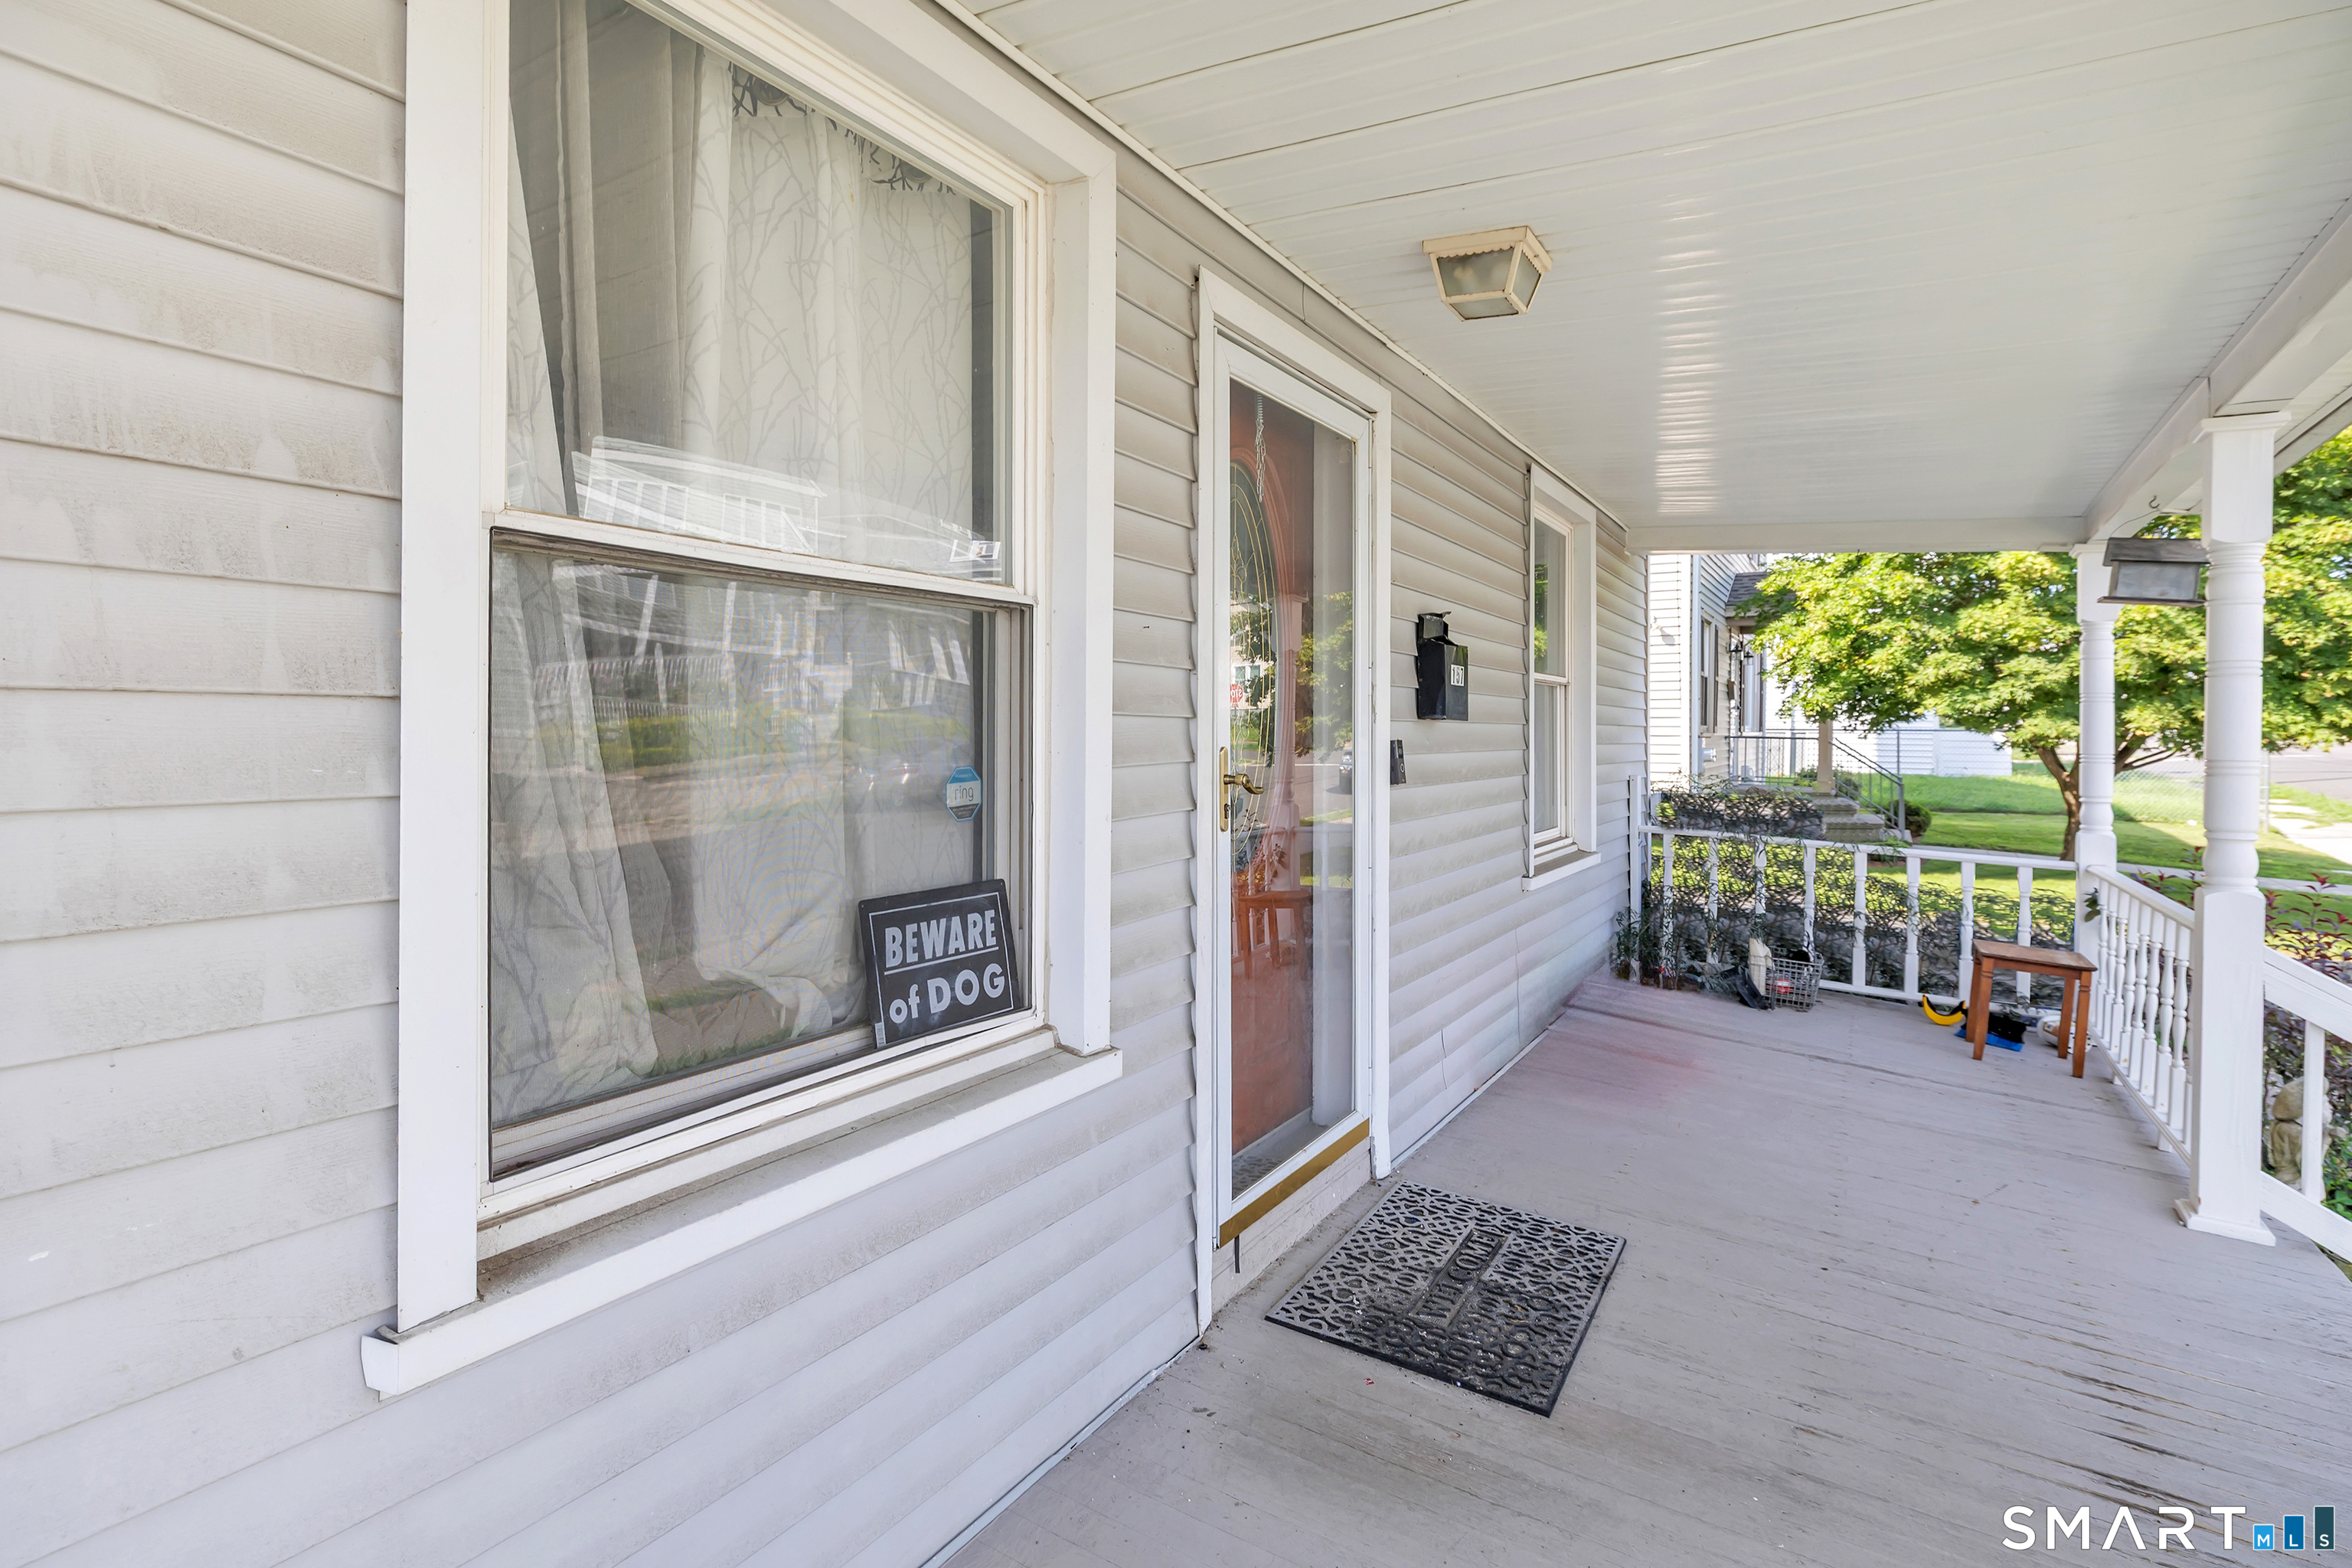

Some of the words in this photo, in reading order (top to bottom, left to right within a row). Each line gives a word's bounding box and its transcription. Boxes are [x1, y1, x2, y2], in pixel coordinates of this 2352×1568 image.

[955, 785, 974, 802] ring
[885, 909, 997, 969] BEWARE
[889, 983, 920, 1024] of
[926, 962, 1005, 1014] DOG
